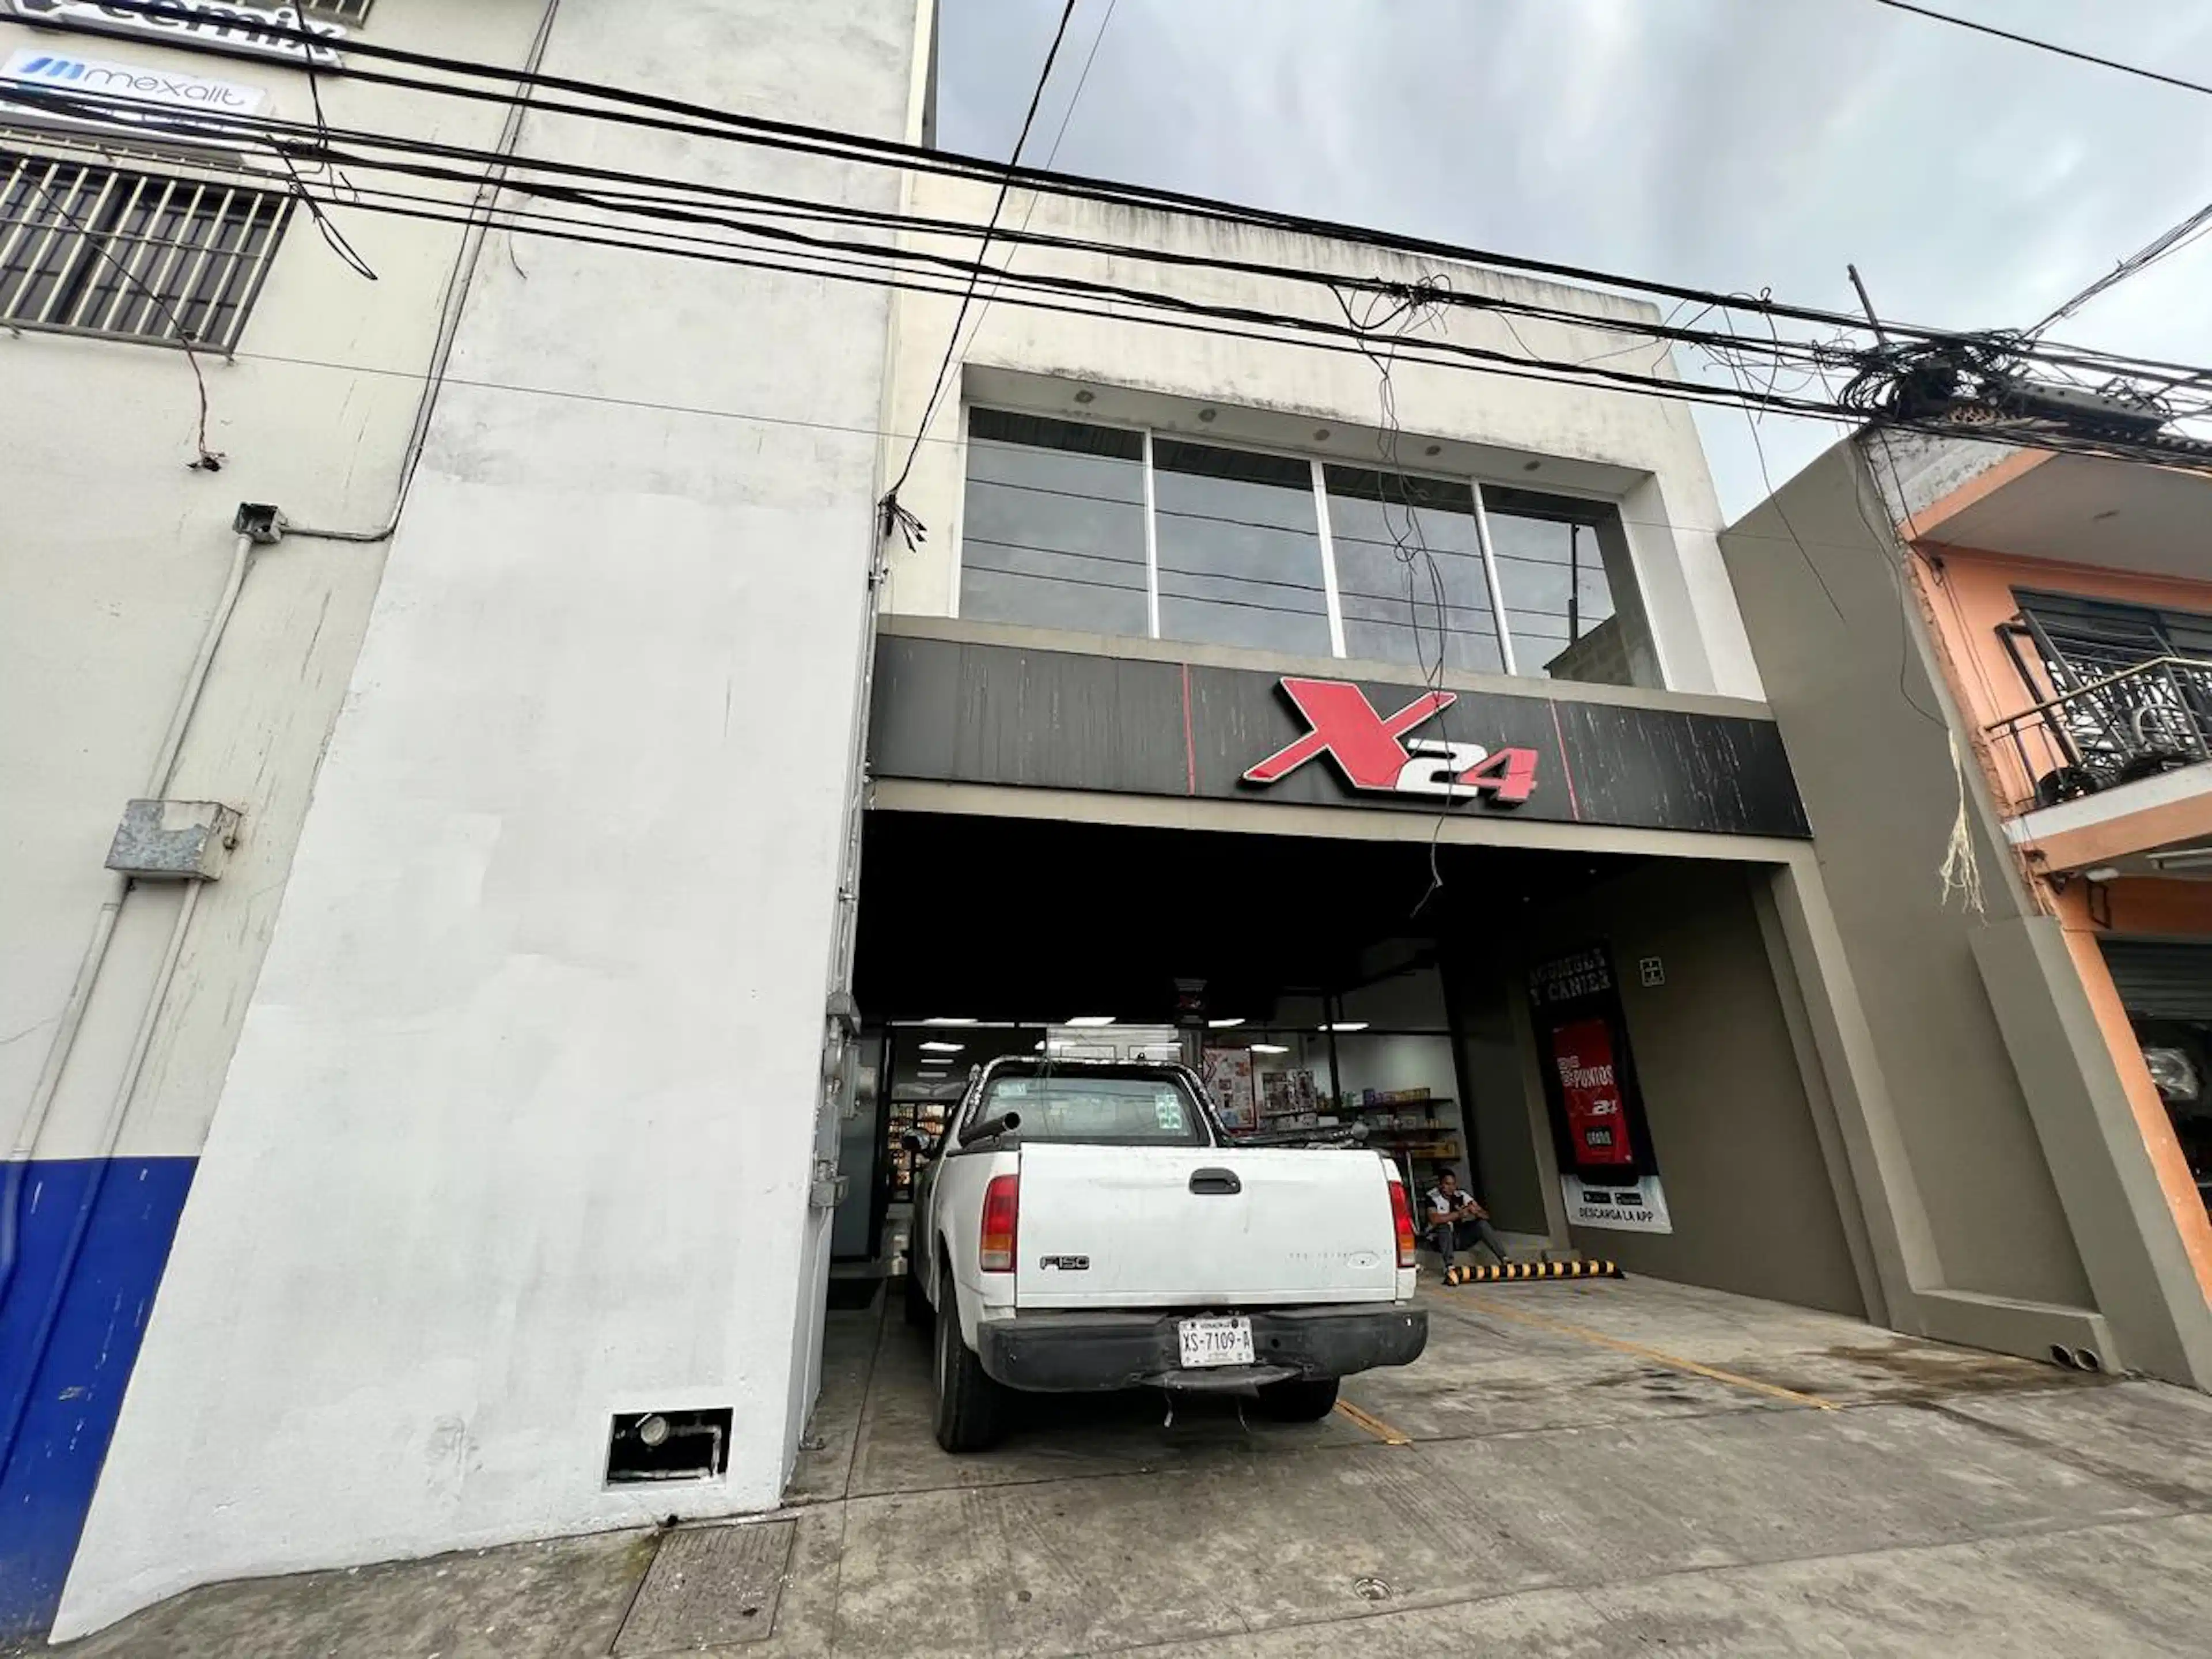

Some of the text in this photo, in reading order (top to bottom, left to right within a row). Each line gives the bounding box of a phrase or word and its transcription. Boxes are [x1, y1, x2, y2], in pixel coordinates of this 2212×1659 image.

[1241, 676, 1539, 804] X24
[1580, 1207, 1621, 1221] DESCARGA
[1636, 1211, 1654, 1222] APP
[1183, 1331, 1250, 1352] XS-7109-A
